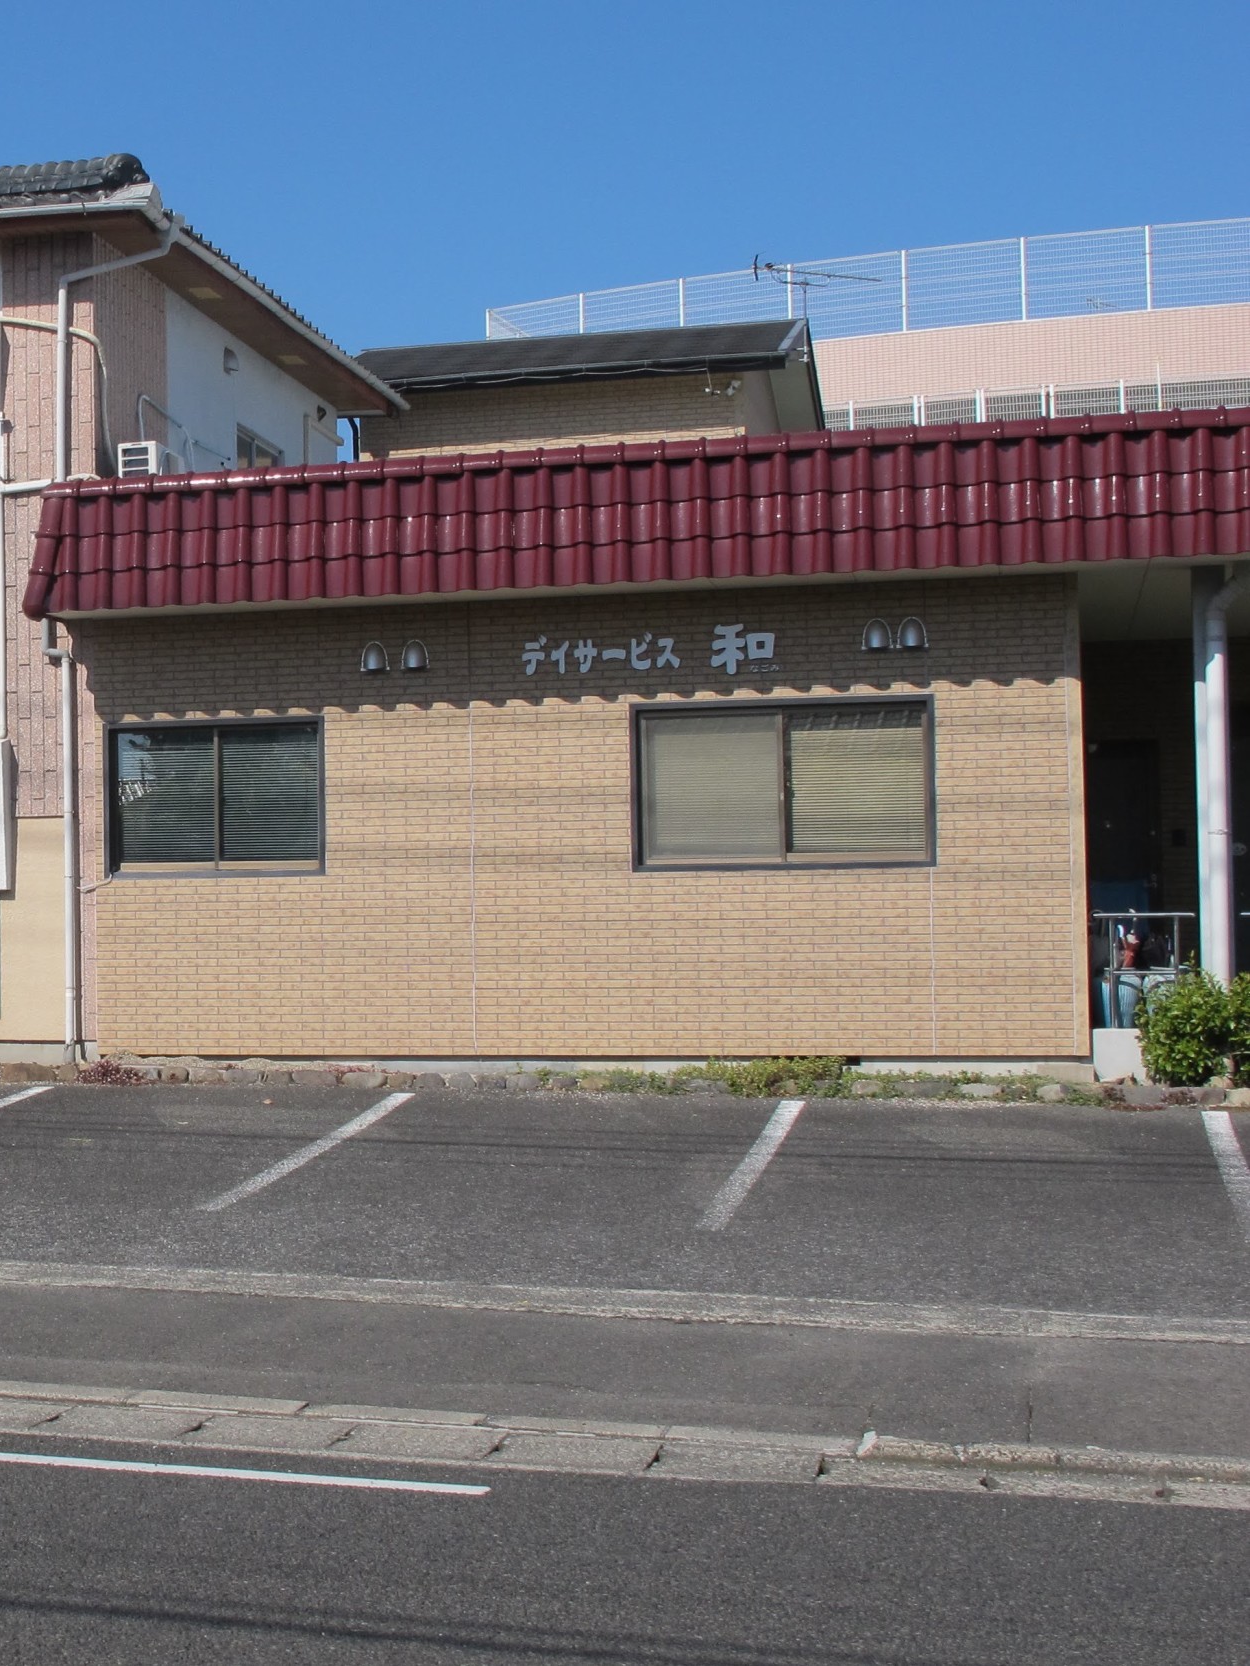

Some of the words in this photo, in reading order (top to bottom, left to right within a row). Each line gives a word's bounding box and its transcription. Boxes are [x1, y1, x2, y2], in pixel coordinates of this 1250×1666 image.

[521, 631, 681, 676] デイサービス
[710, 623, 776, 675] 和
[750, 663, 781, 673] なごみ
